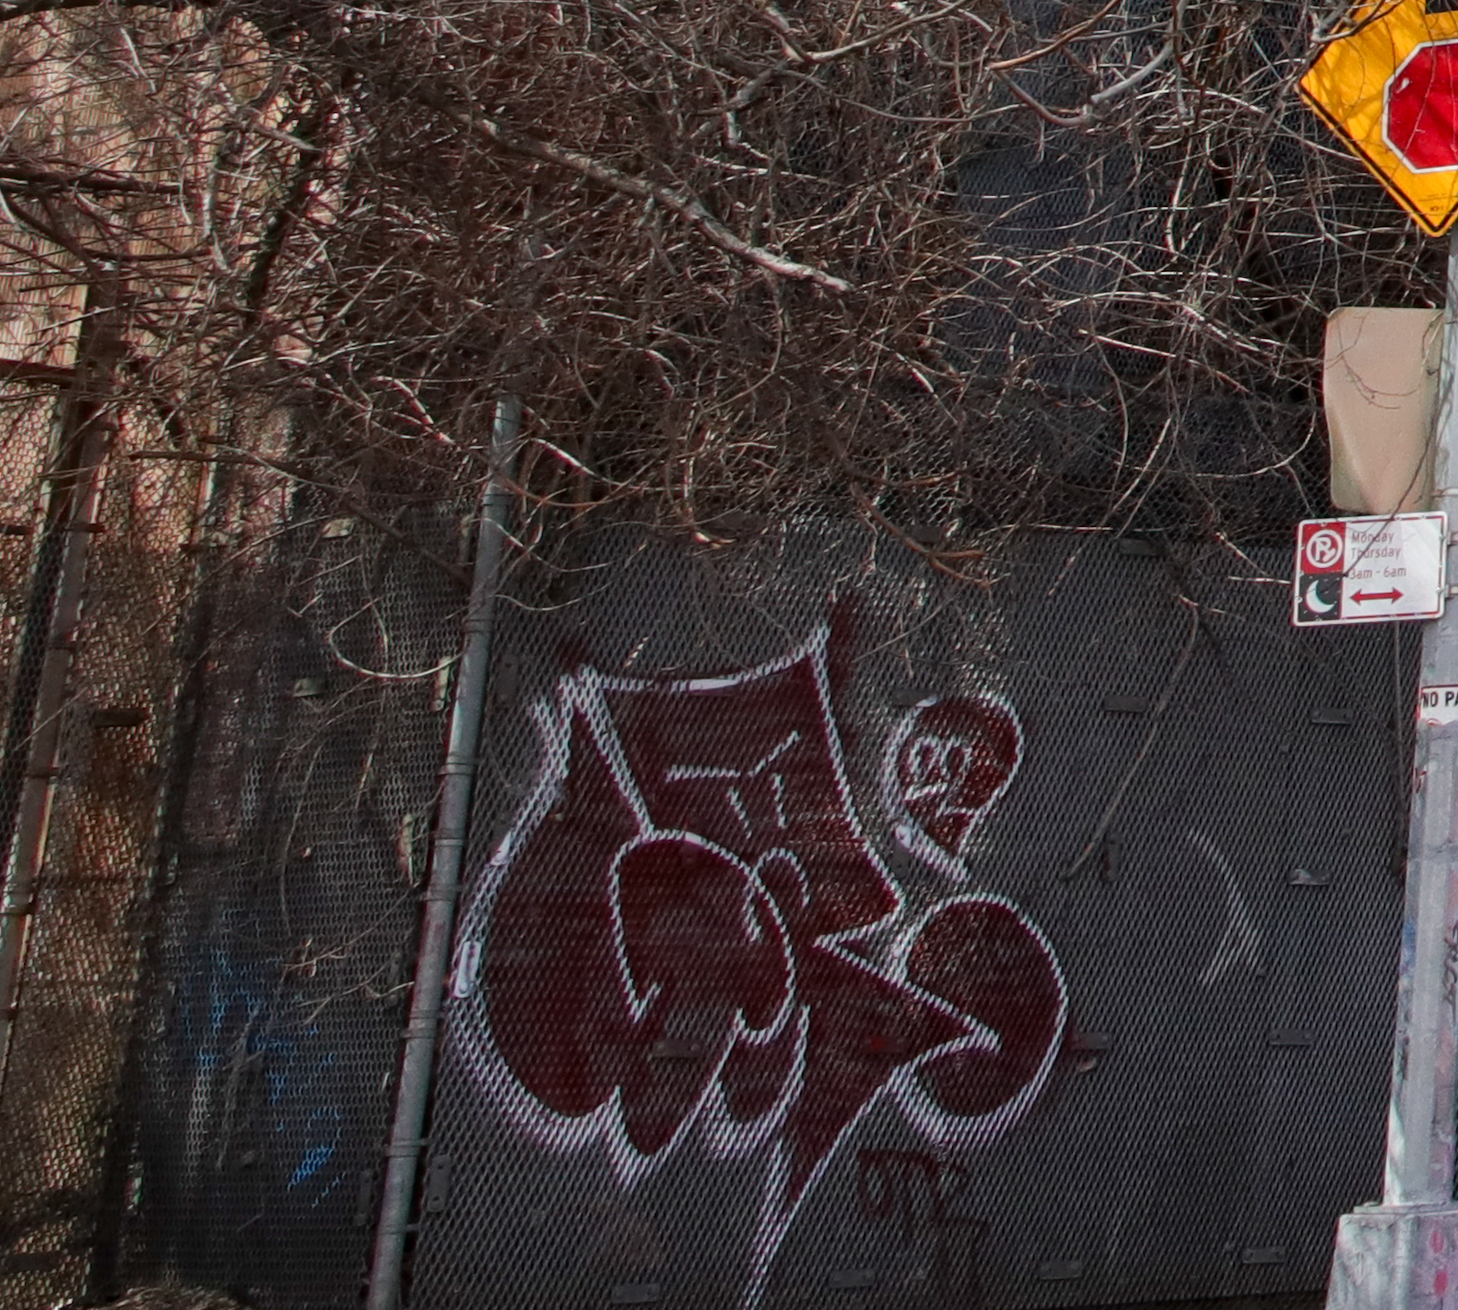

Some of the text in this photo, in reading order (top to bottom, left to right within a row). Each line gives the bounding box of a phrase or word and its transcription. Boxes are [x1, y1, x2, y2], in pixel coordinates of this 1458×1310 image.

[1351, 531, 1394, 544] Monday
[1351, 545, 1401, 559] Thursday
[1350, 568, 1373, 580] 3am
[1383, 566, 1407, 578] 6am
[1421, 691, 1439, 708] NO
